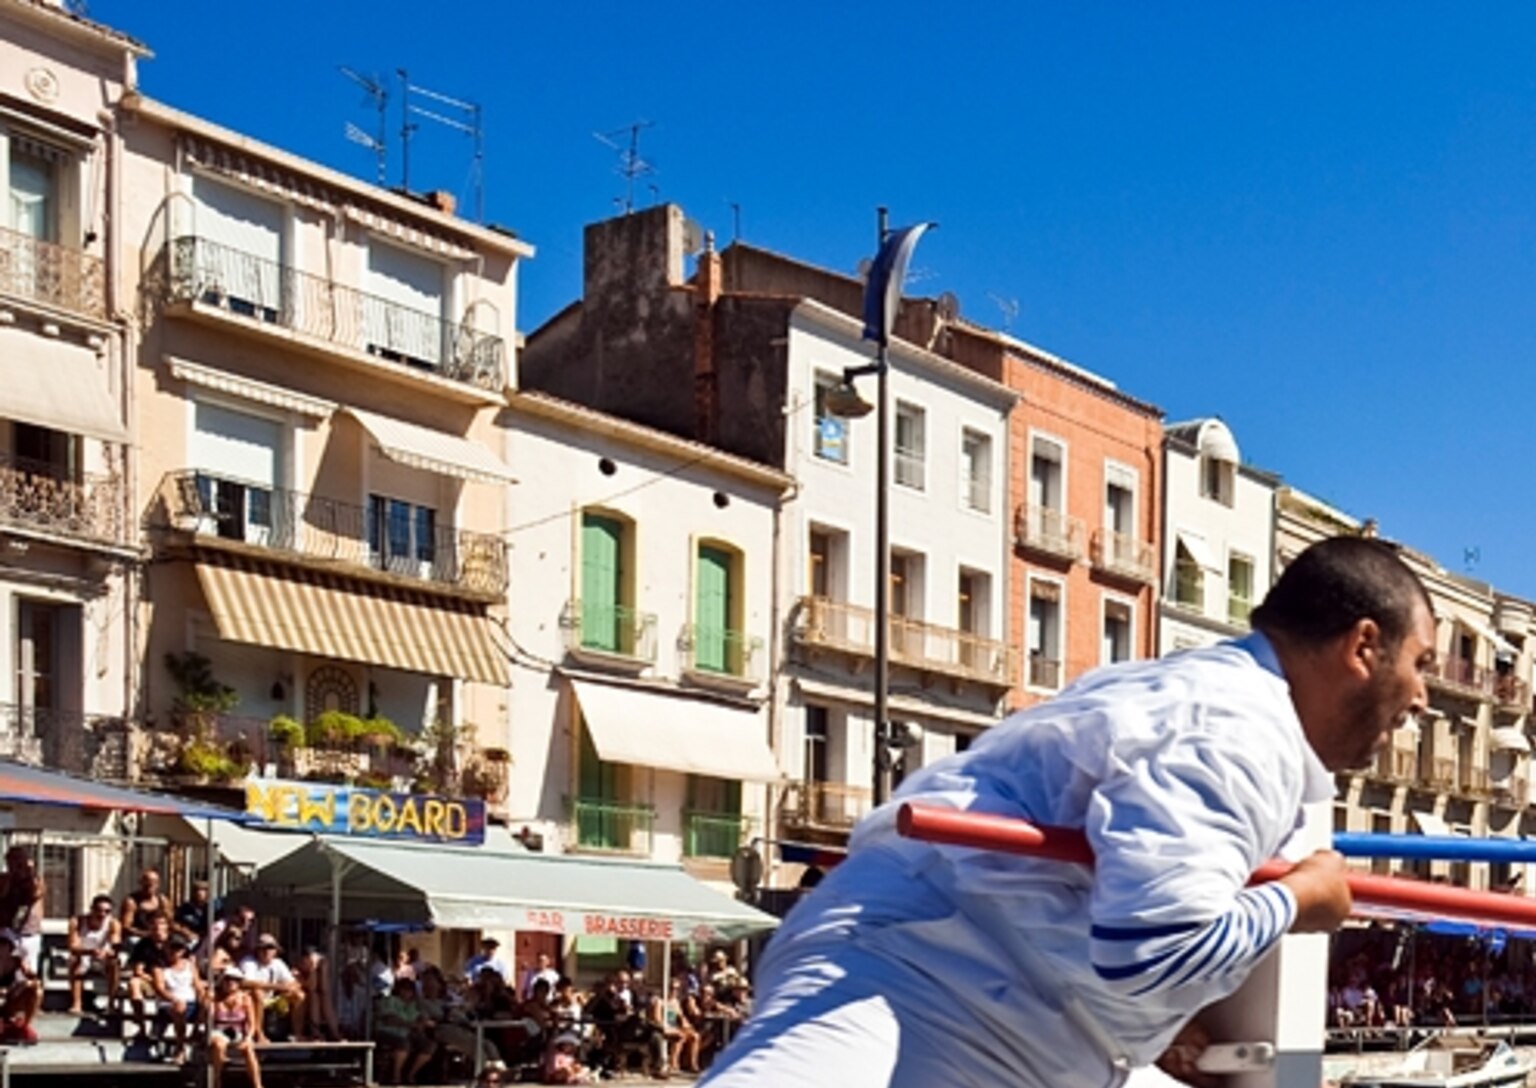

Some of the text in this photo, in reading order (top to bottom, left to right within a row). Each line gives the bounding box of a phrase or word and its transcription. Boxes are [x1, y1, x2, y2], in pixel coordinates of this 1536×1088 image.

[245, 784, 467, 839] NEW BOARD
[584, 914, 673, 937] BRASSERIE
